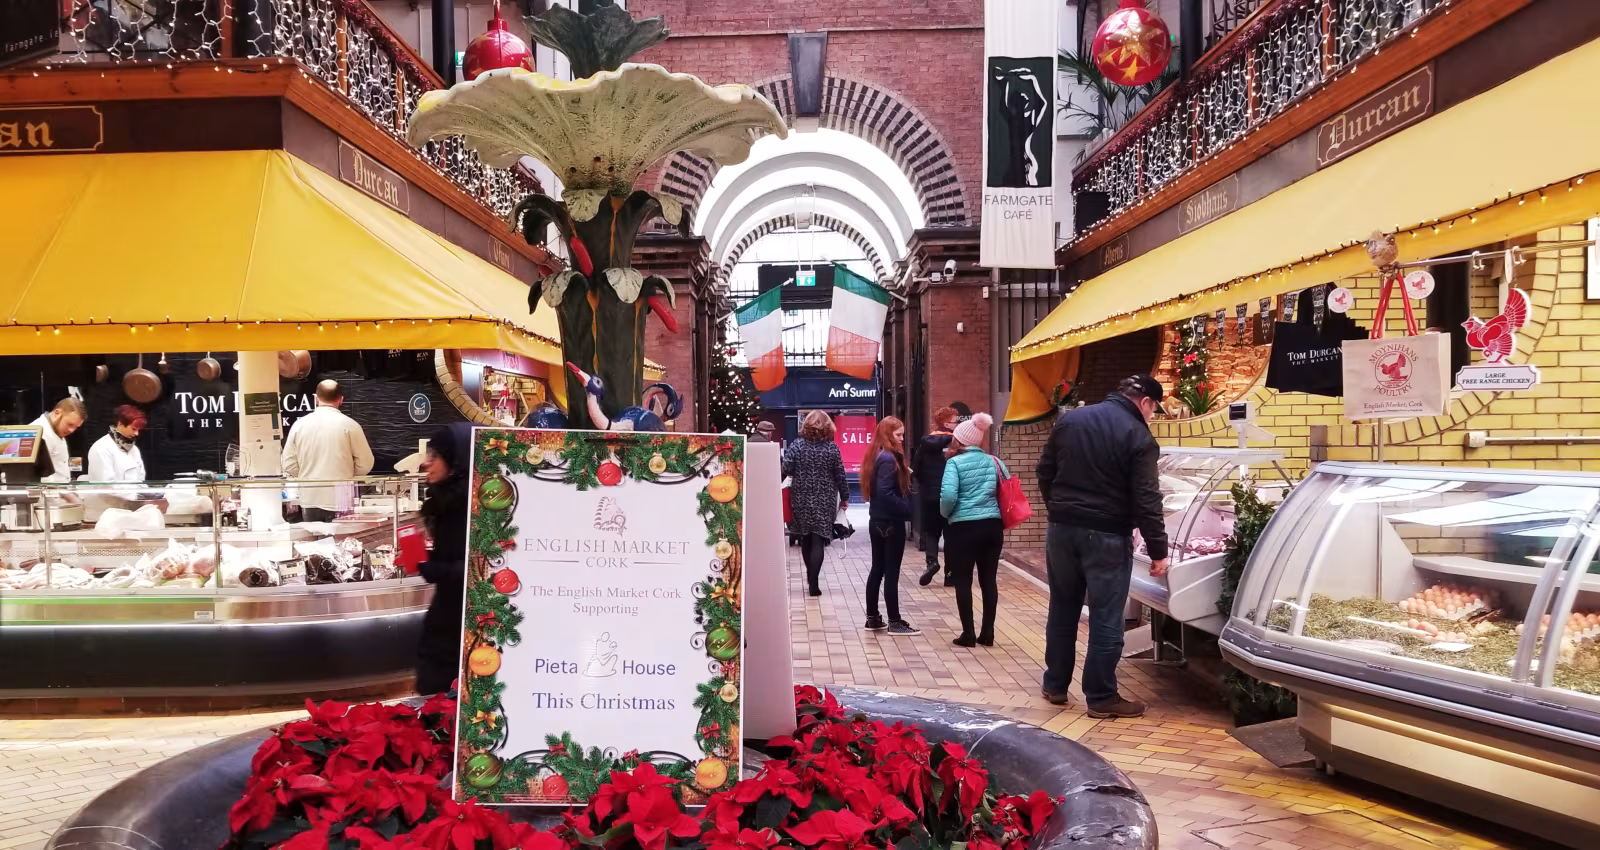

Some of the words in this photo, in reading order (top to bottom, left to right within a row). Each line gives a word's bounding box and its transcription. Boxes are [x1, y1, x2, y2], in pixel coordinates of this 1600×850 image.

[1326, 84, 1420, 161] Durcan
[353, 149, 399, 207] Durcan
[984, 194, 1053, 206] FARMGATE
[1003, 208, 1033, 220] CAFÉ
[1287, 352, 1307, 361] TOM
[1309, 346, 1343, 359] DURCAN
[1310, 354, 1339, 364] MARKET
[1368, 344, 1419, 364] MOYNIHANS
[828, 387, 848, 398] Ann
[1373, 382, 1412, 397] POULTRY
[174, 391, 226, 414] TOM
[1363, 402, 1385, 410] English
[1408, 400, 1423, 408] Cork
[187, 418, 223, 428] THE
[842, 432, 873, 444] SALE
[524, 538, 606, 553] ENGLISH
[612, 541, 691, 555] MARKET
[585, 556, 629, 569] CORK
[530, 585, 554, 597] The
[557, 585, 602, 600] English
[606, 587, 650, 599] Market
[652, 587, 683, 599] Cork
[572, 602, 640, 617] Supporting
[534, 658, 579, 674] Pieta
[621, 659, 677, 676] House
[532, 692, 574, 709] This
[580, 692, 676, 711] Christmas
